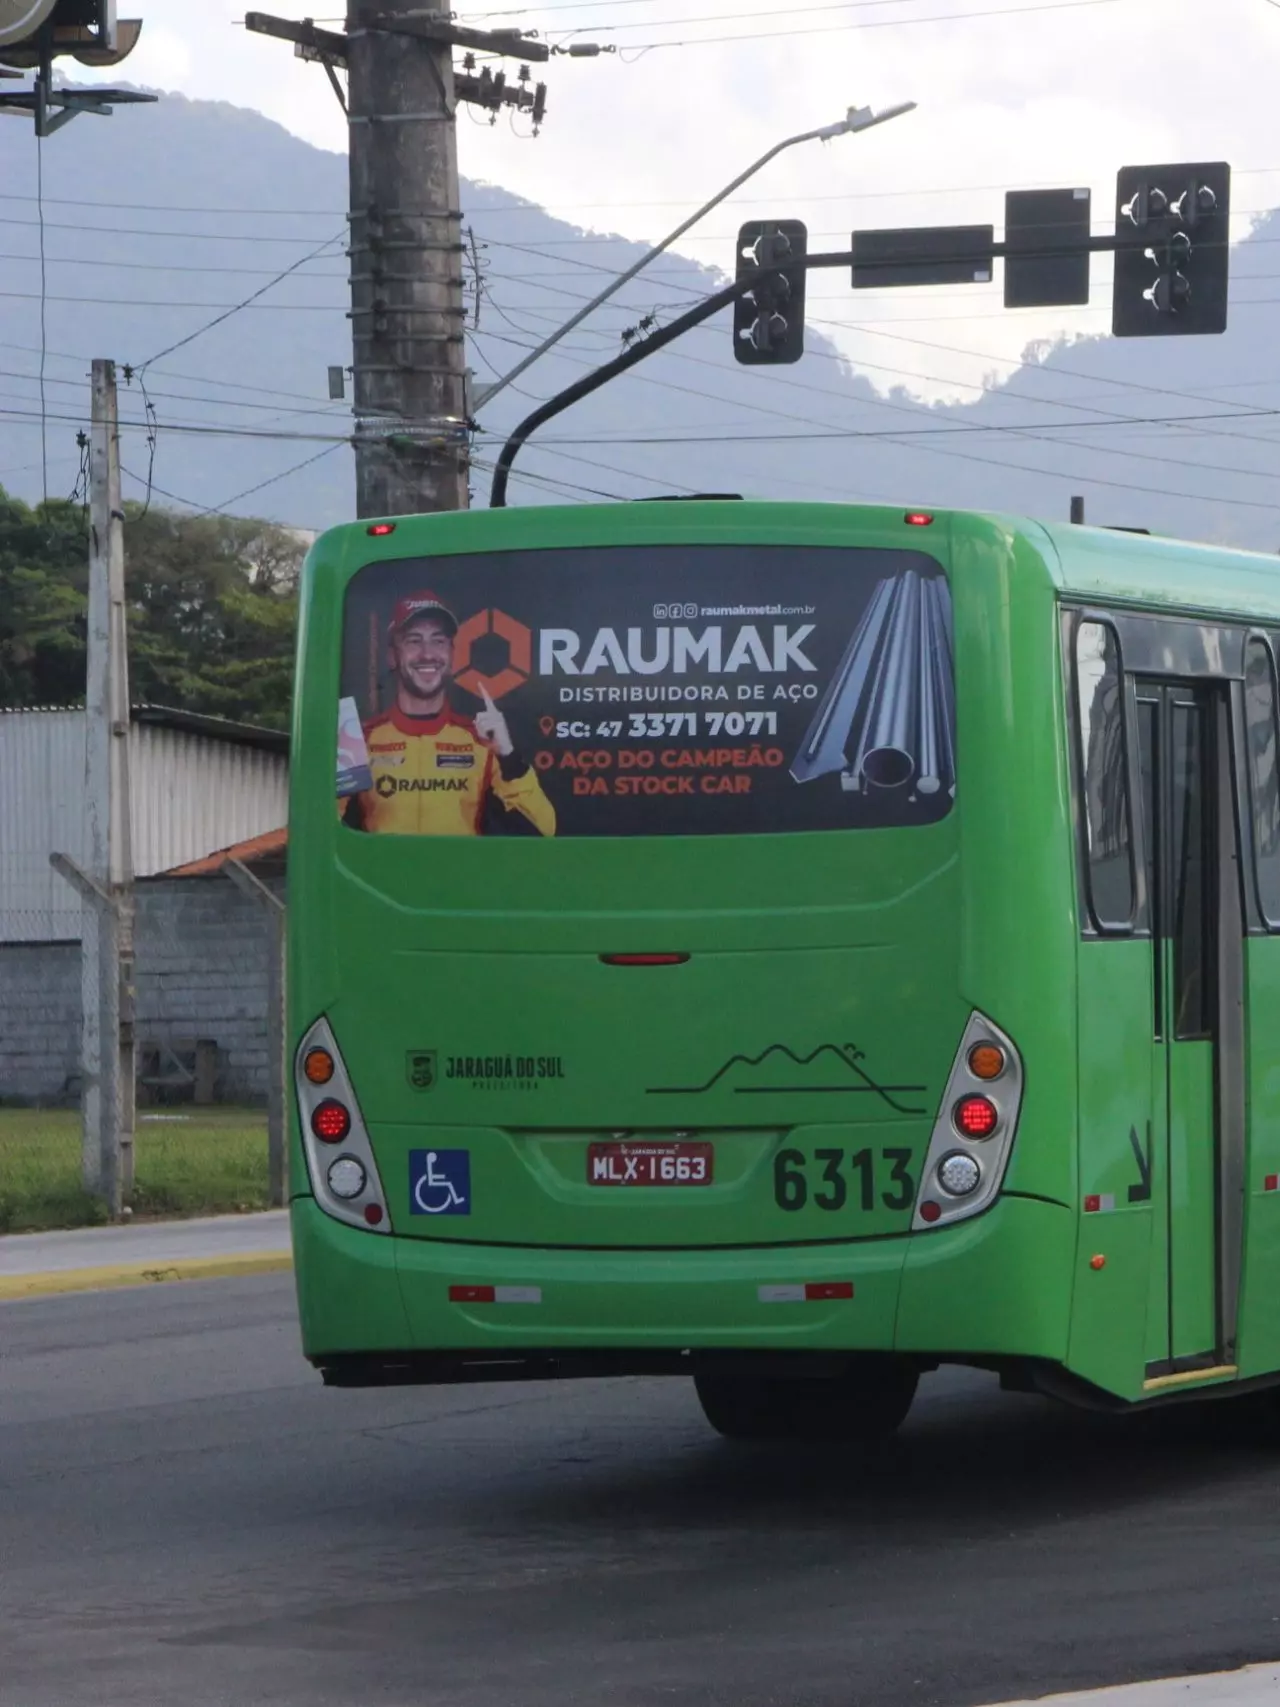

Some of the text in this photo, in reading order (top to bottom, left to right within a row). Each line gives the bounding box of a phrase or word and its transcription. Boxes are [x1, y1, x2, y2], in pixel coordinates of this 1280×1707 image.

[700, 604, 816, 616] raumakmetal.com.br
[539, 624, 818, 676] RAUMAK
[559, 684, 818, 704] DISTRIBUIDORA DE AÇO
[556, 711, 778, 738] SC: 47 3371 7071
[534, 744, 784, 775] O AÇO DO CAMPEÃO
[398, 778, 469, 793] RAUMAK
[573, 775, 751, 795] DA STOCK CAR
[446, 1053, 565, 1079] JARAGUÁ DO SUL
[773, 1148, 915, 1212] 6313
